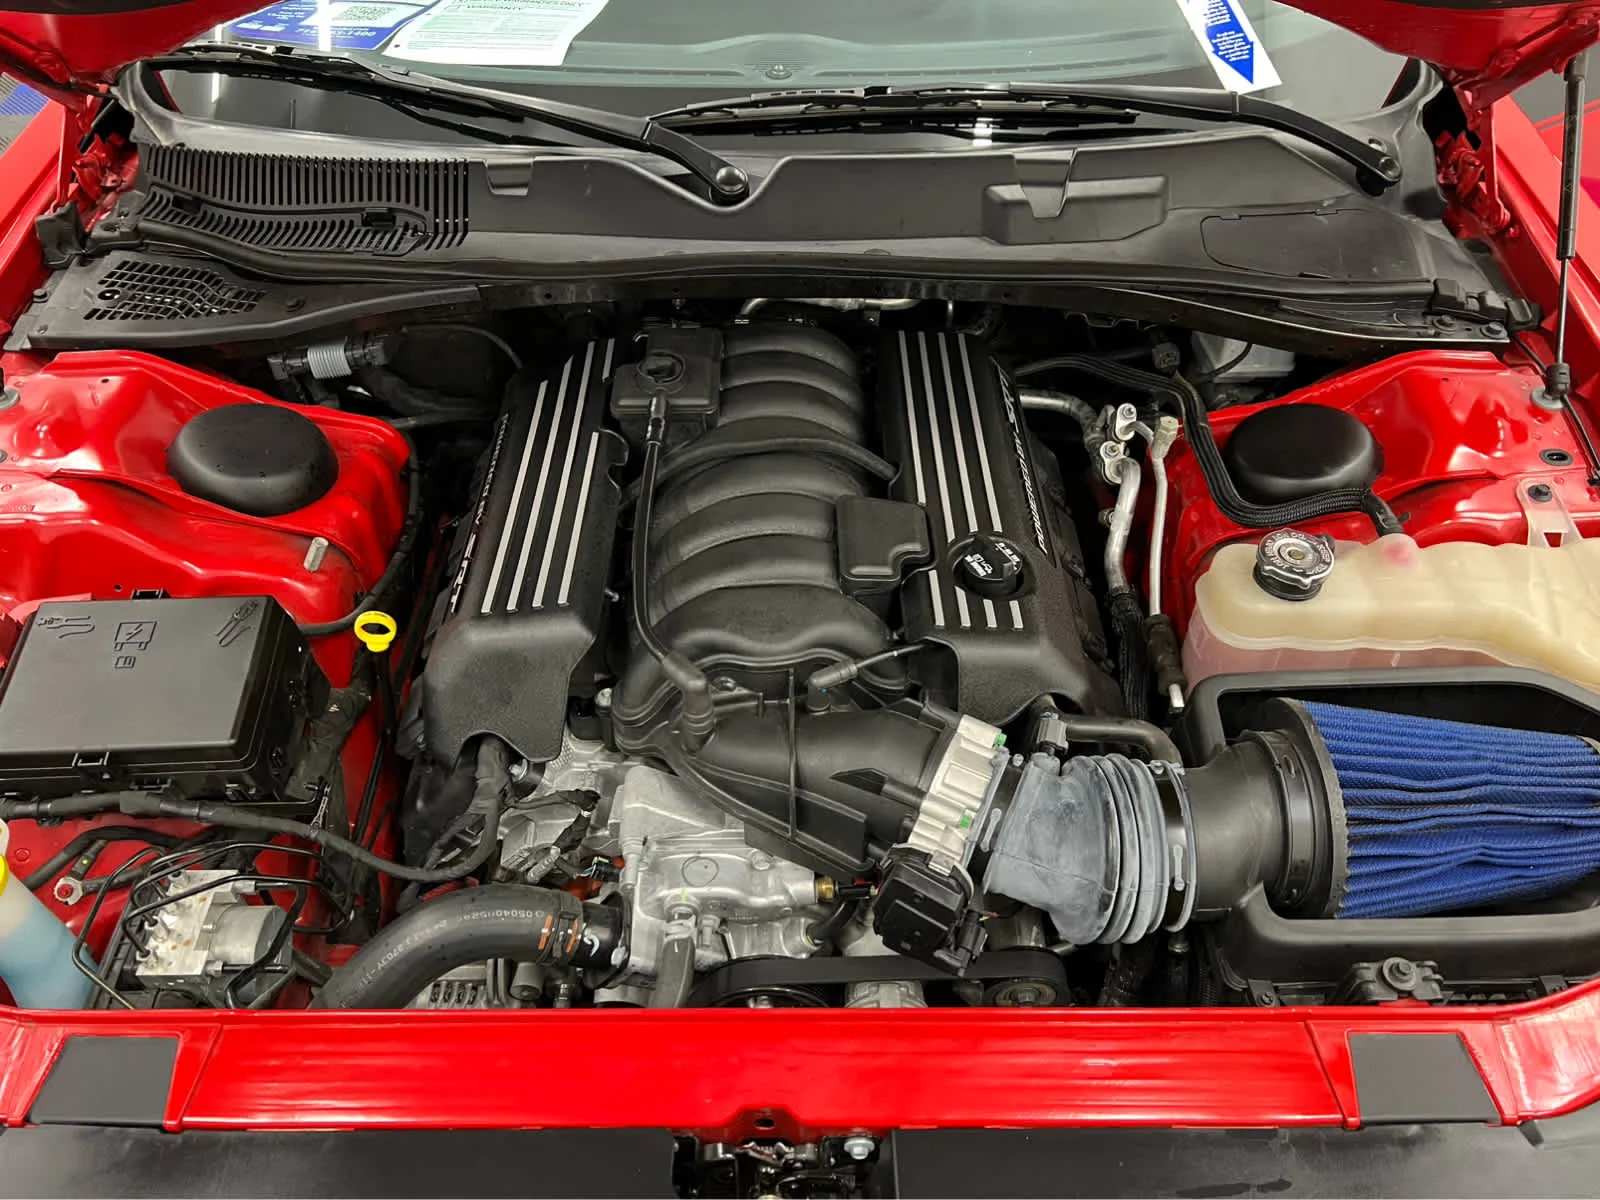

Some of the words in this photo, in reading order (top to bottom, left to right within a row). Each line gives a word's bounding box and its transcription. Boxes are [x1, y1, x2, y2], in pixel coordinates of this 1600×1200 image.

[989, 355, 1019, 434] SRT
[483, 413, 509, 497] POWERED
[1013, 431, 1025, 460] BY
[1019, 458, 1048, 555] POWERED
[450, 533, 477, 614] SRT
